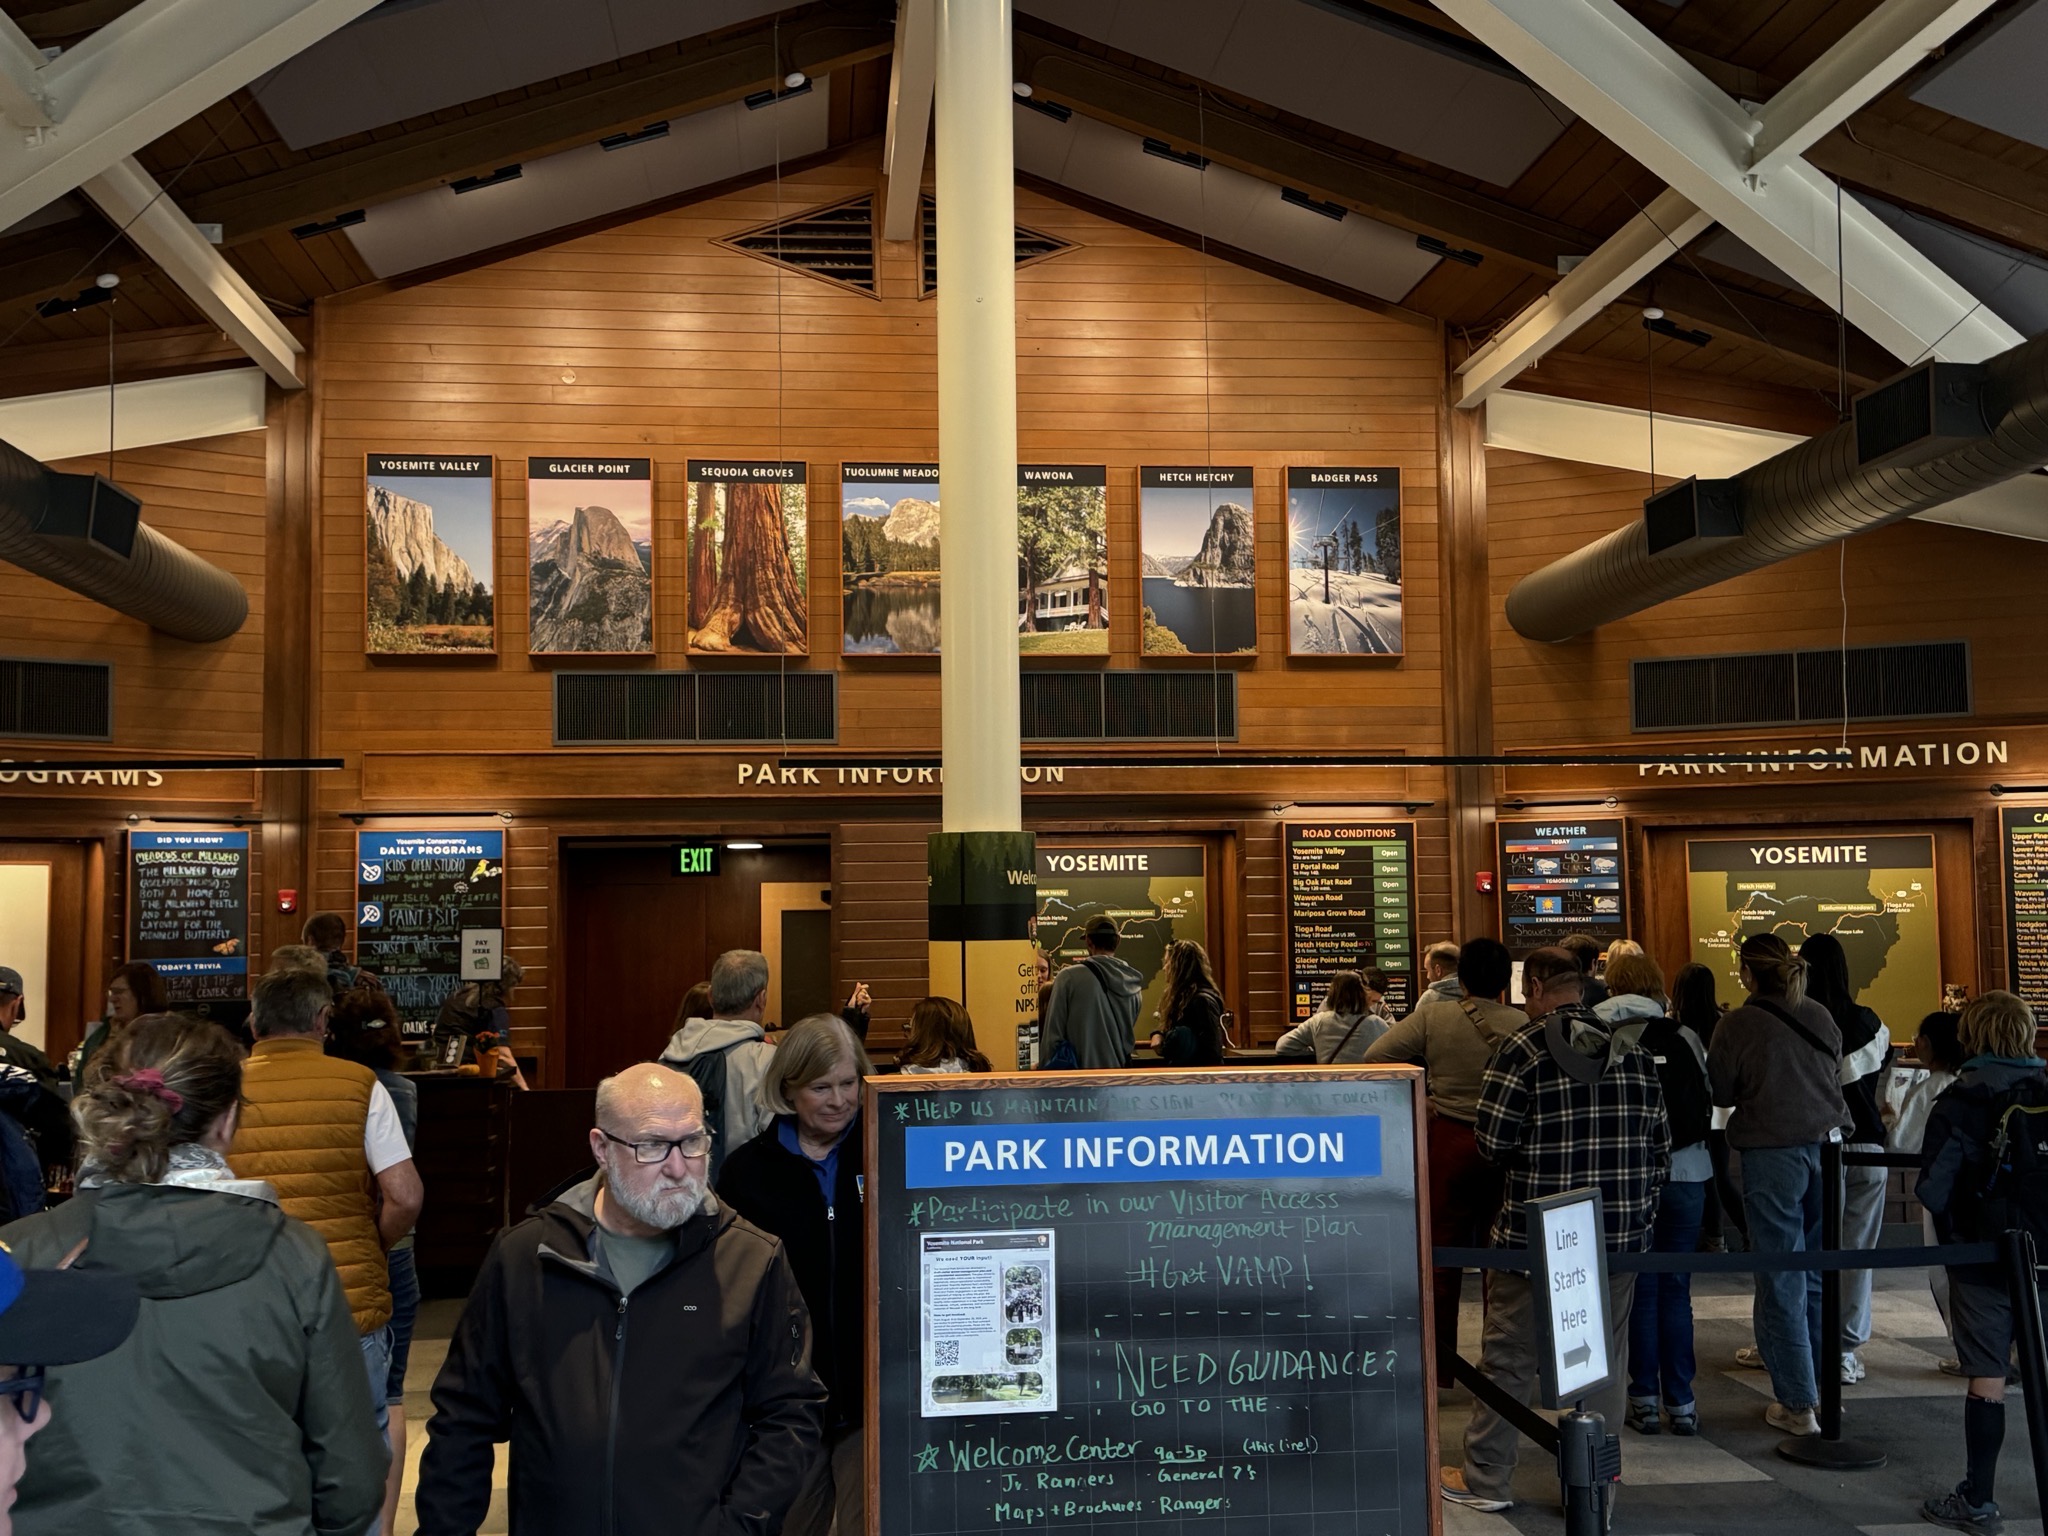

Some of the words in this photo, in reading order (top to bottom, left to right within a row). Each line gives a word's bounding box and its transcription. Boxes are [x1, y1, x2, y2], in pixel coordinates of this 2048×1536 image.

[380, 461, 435, 471] YOSEMITE
[440, 462, 480, 471] VALLEY
[549, 464, 594, 473] GLACIER
[598, 465, 631, 473] POINT
[701, 467, 749, 477] SEQUOIA
[752, 468, 794, 478] GROVES
[845, 468, 899, 477] TUOLUMNE
[1024, 471, 1073, 480] WAWONA
[1160, 473, 1191, 482] HETCH
[1196, 473, 1234, 482] HETCHY
[1311, 474, 1350, 482] BADGER
[1355, 474, 1378, 482] PASS
[1639, 753, 1726, 776] PARK
[1746, 741, 2008, 772] INFORMATION
[737, 763, 820, 784] PARK
[1302, 829, 1331, 838] ROAD
[1334, 829, 1396, 838] CONDITIONS
[1535, 827, 1587, 836] WEATHER
[136, 851, 177, 862] MEADOWS
[199, 851, 239, 861] MILKWEED
[380, 847, 413, 855] DAILY
[418, 846, 483, 854] PROGRAMS
[1325, 847, 1345, 855] Valley
[1750, 845, 1867, 864] YOSEMITE
[680, 847, 713, 872] EXIT
[1046, 855, 1149, 872] YOSEMITE
[1511, 854, 1525, 864] 64
[1564, 853, 1579, 862] 40
[385, 859, 406, 871] KIDS
[435, 858, 465, 871] STUDIO
[138, 868, 158, 877] THE
[163, 866, 207, 875] MILKWEED
[212, 867, 239, 876] PLANT
[140, 889, 164, 898] BOTH
[187, 890, 213, 898] HOME
[1512, 892, 1528, 902] 73
[1568, 891, 1581, 902] 44
[165, 900, 205, 908] MILKWEED
[389, 909, 424, 926] PAINT
[435, 909, 459, 925] SIP
[185, 930, 230, 939] BUTTERFLY
[1295, 925, 1313, 933] Tioga
[1514, 924, 1552, 935] Showers
[372, 943, 406, 954] SUNSET
[1316, 941, 1339, 949] Hetchy
[1018, 964, 1035, 977] Get
[1016, 999, 1034, 1012] NPS
[402, 1021, 429, 1034] ONLINE
[915, 1099, 962, 1121] HELP
[971, 1101, 994, 1118] US
[1003, 1098, 1098, 1115] MAINTAIN
[945, 1138, 1047, 1172] PARK
[1063, 1132, 1344, 1169] INFORMATION
[929, 1195, 1074, 1230] Participate
[1086, 1193, 1109, 1214] in
[1119, 1196, 1161, 1213] our
[1170, 1189, 1251, 1215] Visitor
[1261, 1188, 1339, 1210] Access
[1555, 1228, 1579, 1251] Line
[1125, 1256, 1207, 1289] #Get
[1554, 1266, 1587, 1293] Starts
[1560, 1306, 1588, 1332] Here
[1116, 1341, 1217, 1400] NEED
[1228, 1349, 1398, 1385] GUIDANCE?
[1131, 1400, 1166, 1416] GO
[1179, 1398, 1211, 1414] TO
[948, 1437, 1063, 1472] Welcome
[1066, 1435, 1143, 1461] Center
[1154, 1444, 1208, 1461] 9a-5p
[1243, 1438, 1275, 1455] (this
[1158, 1466, 1224, 1483] General
[1002, 1473, 1029, 1492] Jr.
[1160, 1496, 1231, 1514] Rangers
[995, 1502, 1045, 1524] Maps
[1064, 1500, 1142, 1517] Brochures
